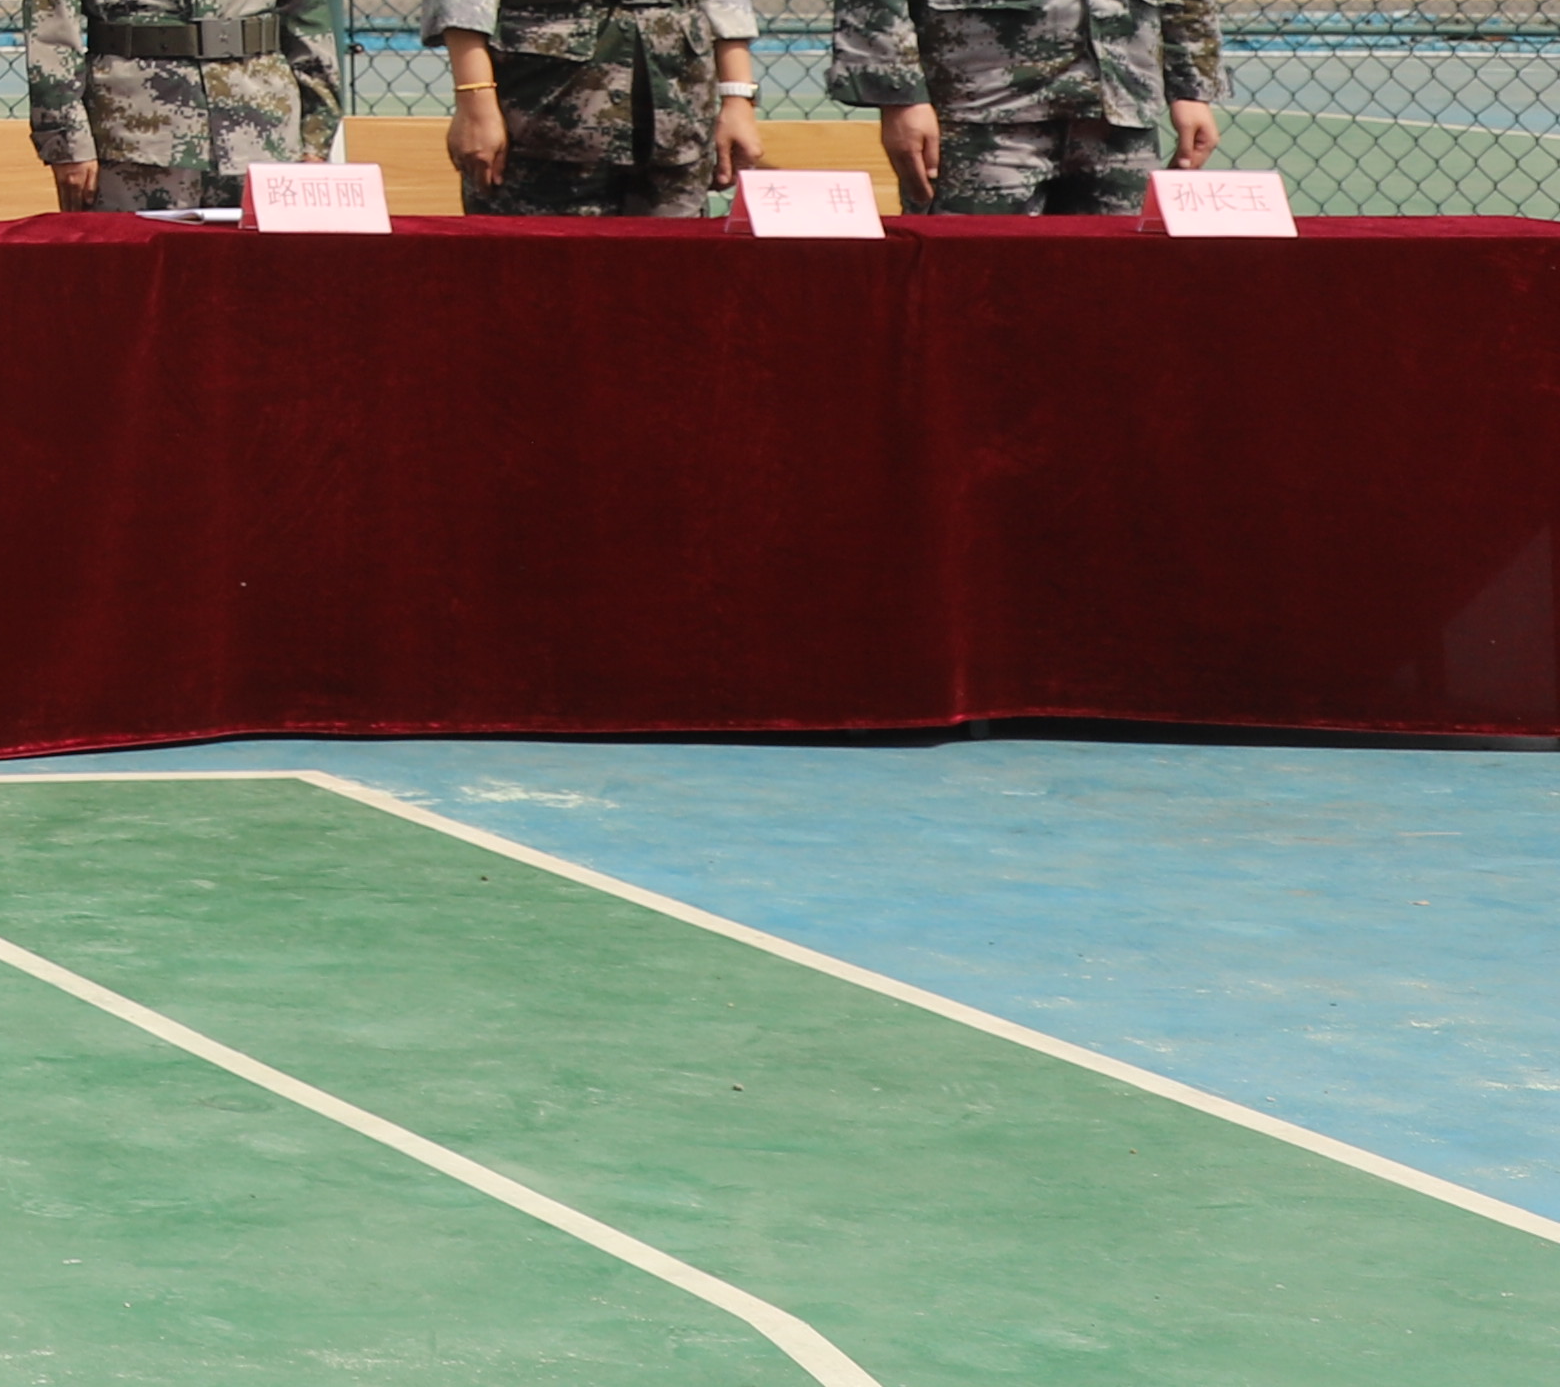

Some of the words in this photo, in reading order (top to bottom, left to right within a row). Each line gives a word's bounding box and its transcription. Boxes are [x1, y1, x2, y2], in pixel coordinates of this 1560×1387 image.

[266, 176, 366, 208] 路丽丽
[757, 183, 856, 214] 李冉
[1172, 182, 1272, 212] 孙长玉
